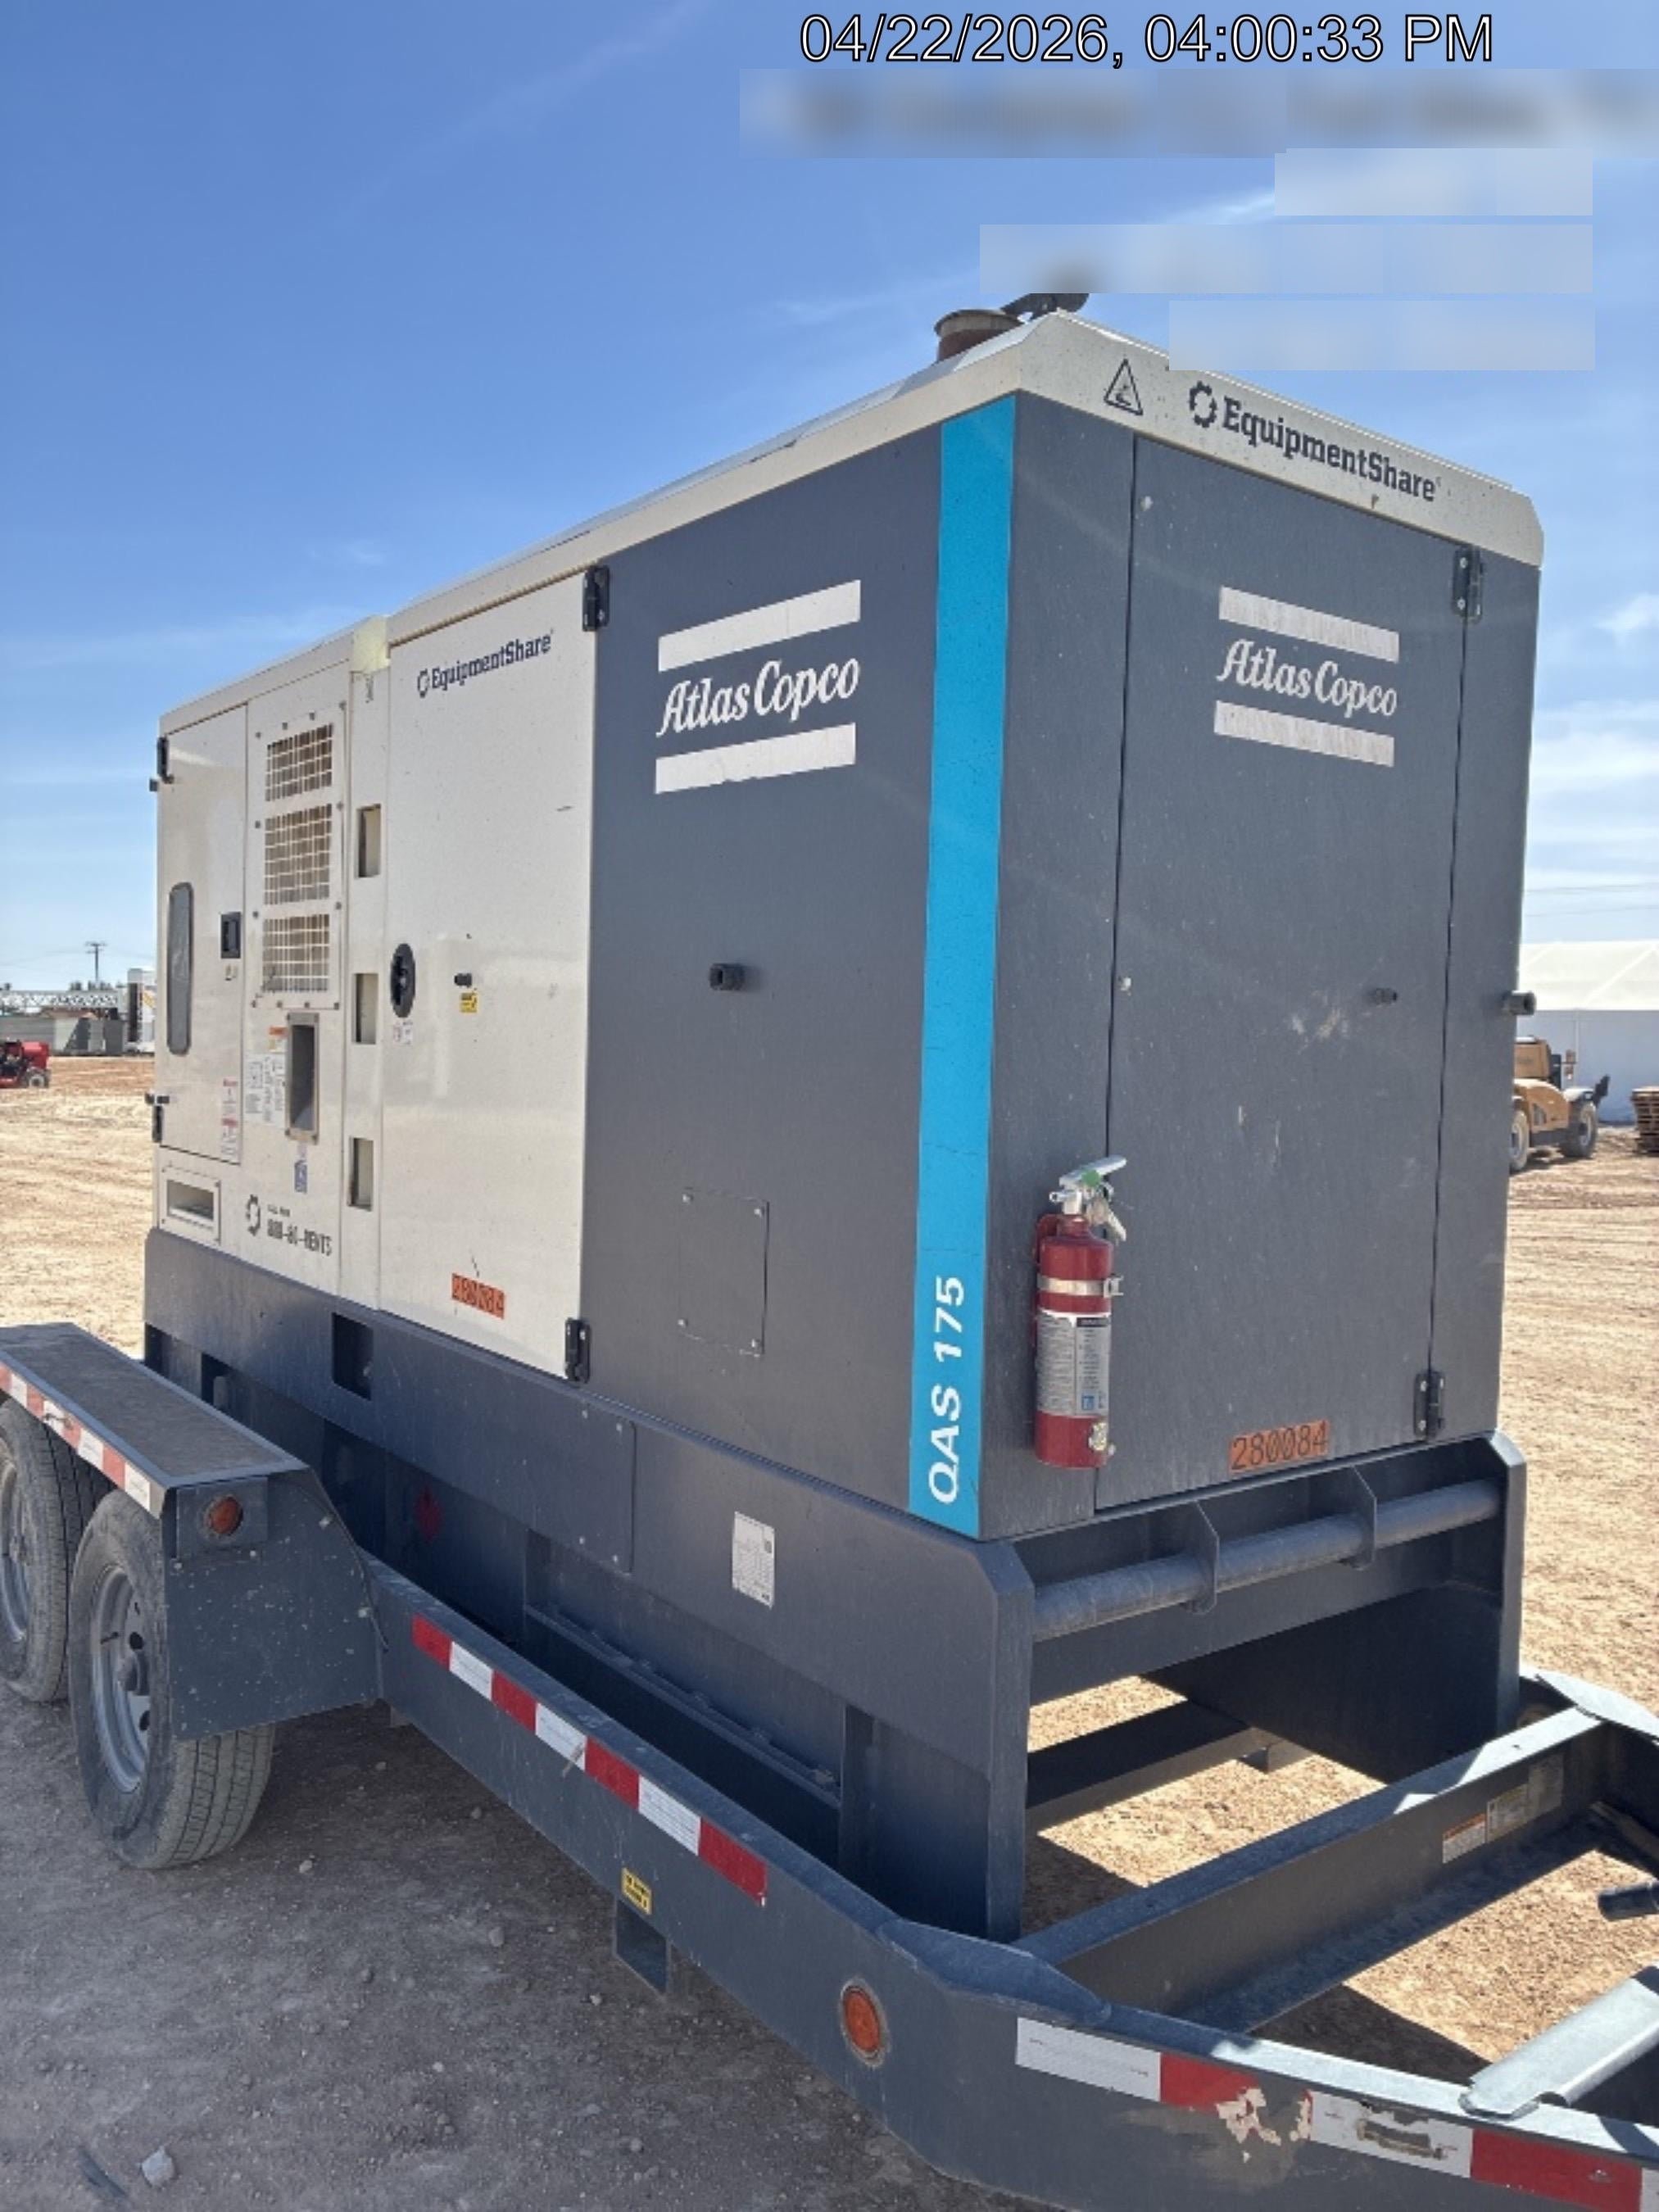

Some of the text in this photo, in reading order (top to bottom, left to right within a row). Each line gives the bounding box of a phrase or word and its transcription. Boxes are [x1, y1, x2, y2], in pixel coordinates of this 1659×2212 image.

[1222, 395, 1436, 502] EquipmentShare
[431, 633, 551, 691] EquipmentShare
[656, 658, 860, 737] Atlas Copco
[1216, 638, 1398, 718] Atlas Copco
[927, 1275, 966, 1505] QAS 175
[1231, 1420, 1329, 1470] 280084
